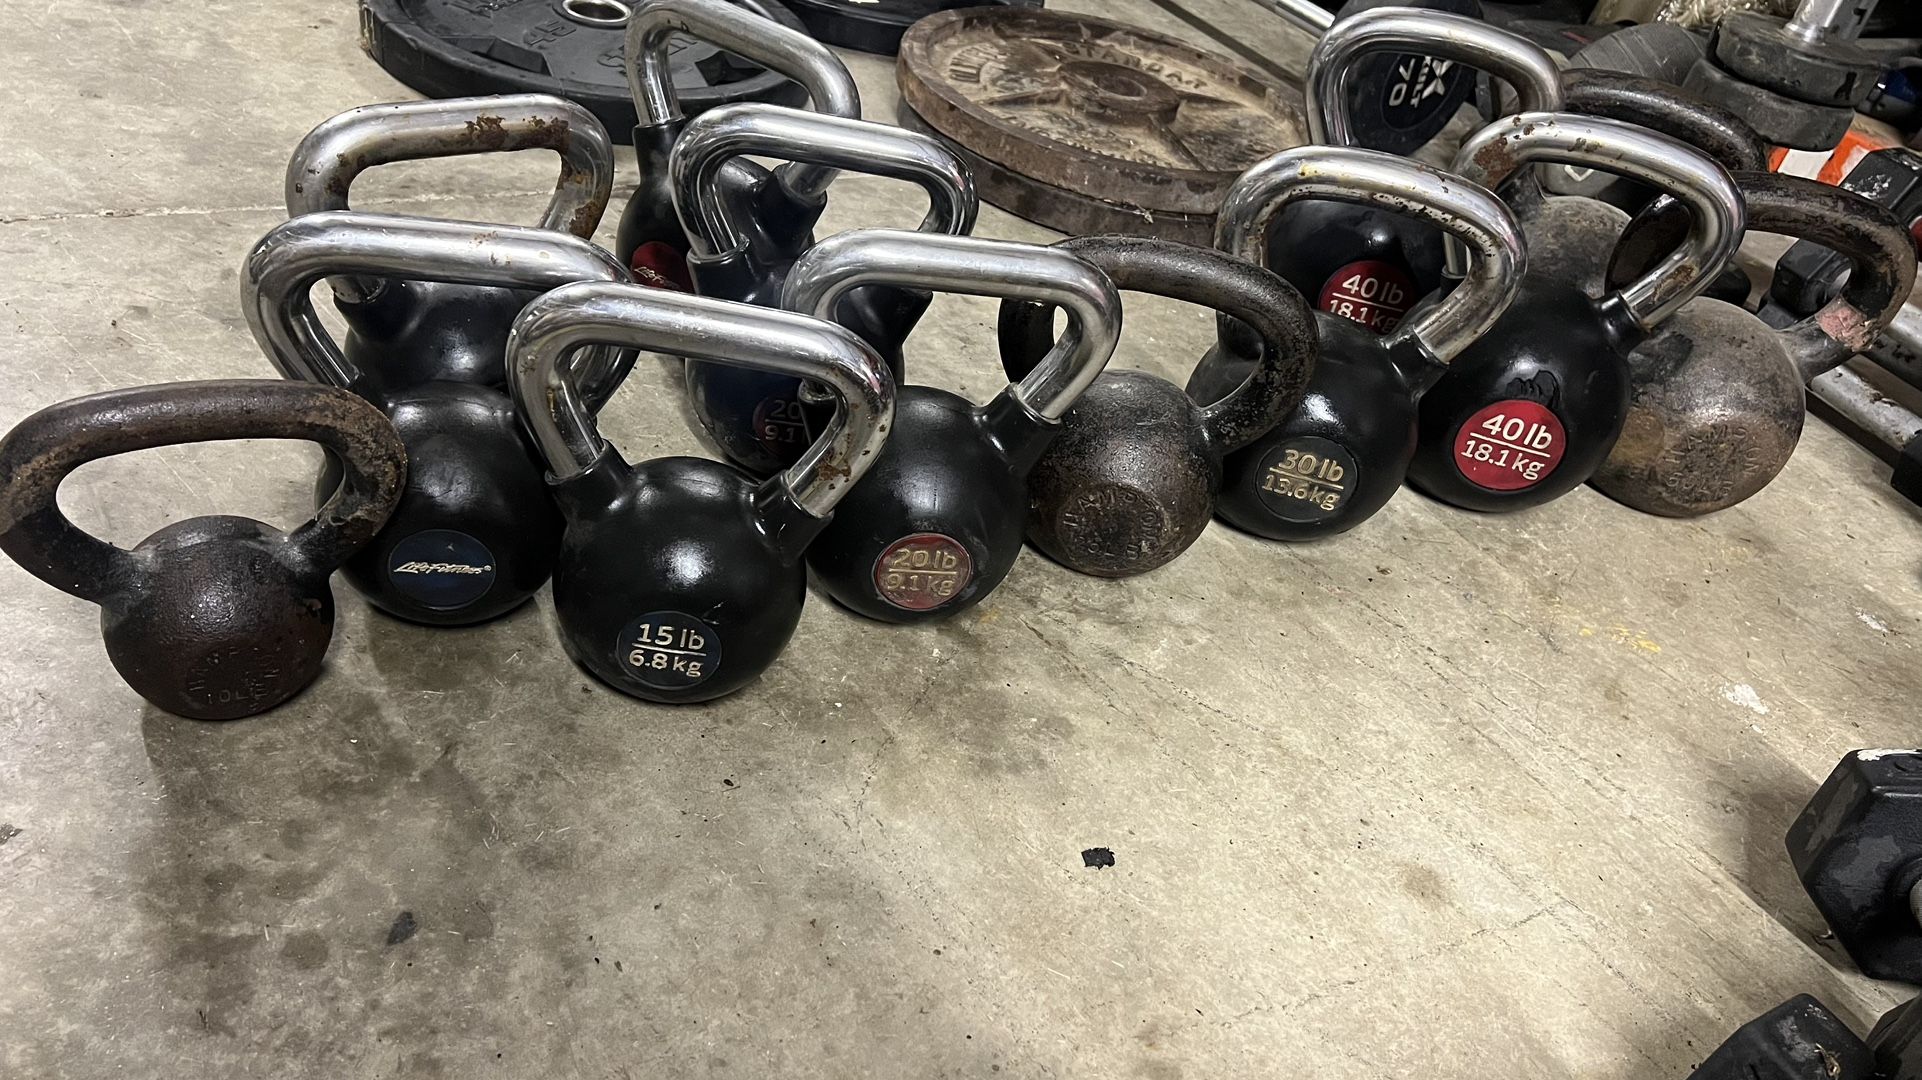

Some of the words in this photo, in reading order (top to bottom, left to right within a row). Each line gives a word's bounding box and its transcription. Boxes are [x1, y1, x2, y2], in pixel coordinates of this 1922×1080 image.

[1389, 58, 1416, 106] 70
[1342, 274, 1379, 298] 40
[1379, 281, 1404, 304] lb
[1330, 299, 1368, 323] 18.1
[770, 400, 803, 420] 20
[1482, 414, 1525, 441] 40
[1523, 423, 1552, 449] lb
[1279, 449, 1317, 474] 30
[1318, 458, 1344, 482] lb
[1461, 440, 1510, 467] 18.1
[1511, 453, 1545, 480] kg
[1262, 475, 1310, 499] 13.6
[1309, 485, 1340, 511] kg
[893, 548, 929, 568] 20
[933, 550, 957, 569] lb
[887, 573, 920, 591] 9.1
[927, 575, 955, 596] kg
[637, 623, 675, 646] 15
[679, 628, 705, 650] lb
[629, 649, 668, 669] 6.8
[672, 656, 704, 678] kg
